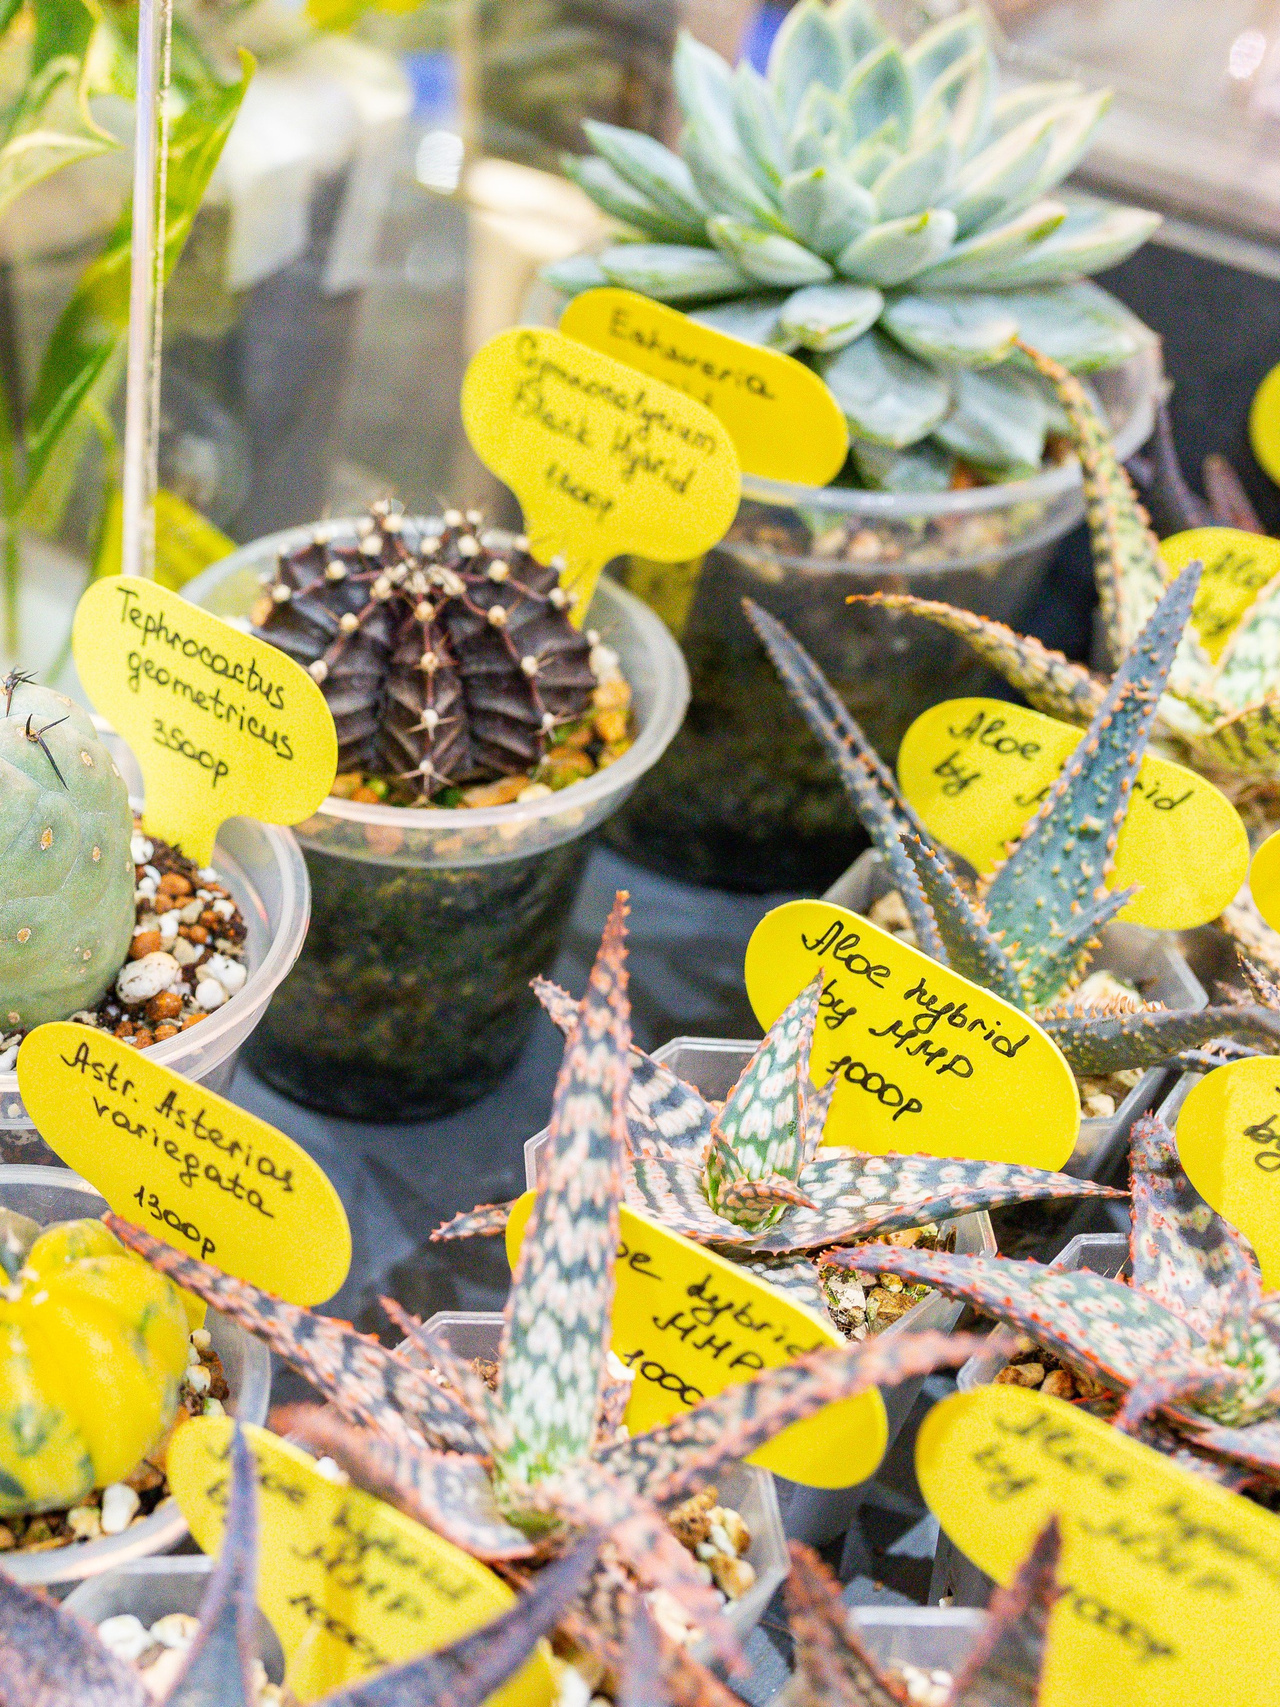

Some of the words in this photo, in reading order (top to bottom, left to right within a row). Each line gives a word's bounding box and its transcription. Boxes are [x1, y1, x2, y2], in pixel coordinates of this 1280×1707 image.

[117, 586, 285, 711] Tephrocactus
[127, 652, 295, 761] geometricus
[948, 711, 1041, 762] Aloe
[801, 920, 892, 989] Aloe
[903, 977, 1031, 1058] hybrid
[818, 979, 858, 1030] by
[93, 1096, 275, 1219] variegata
[154, 1090, 295, 1192] Asterias
